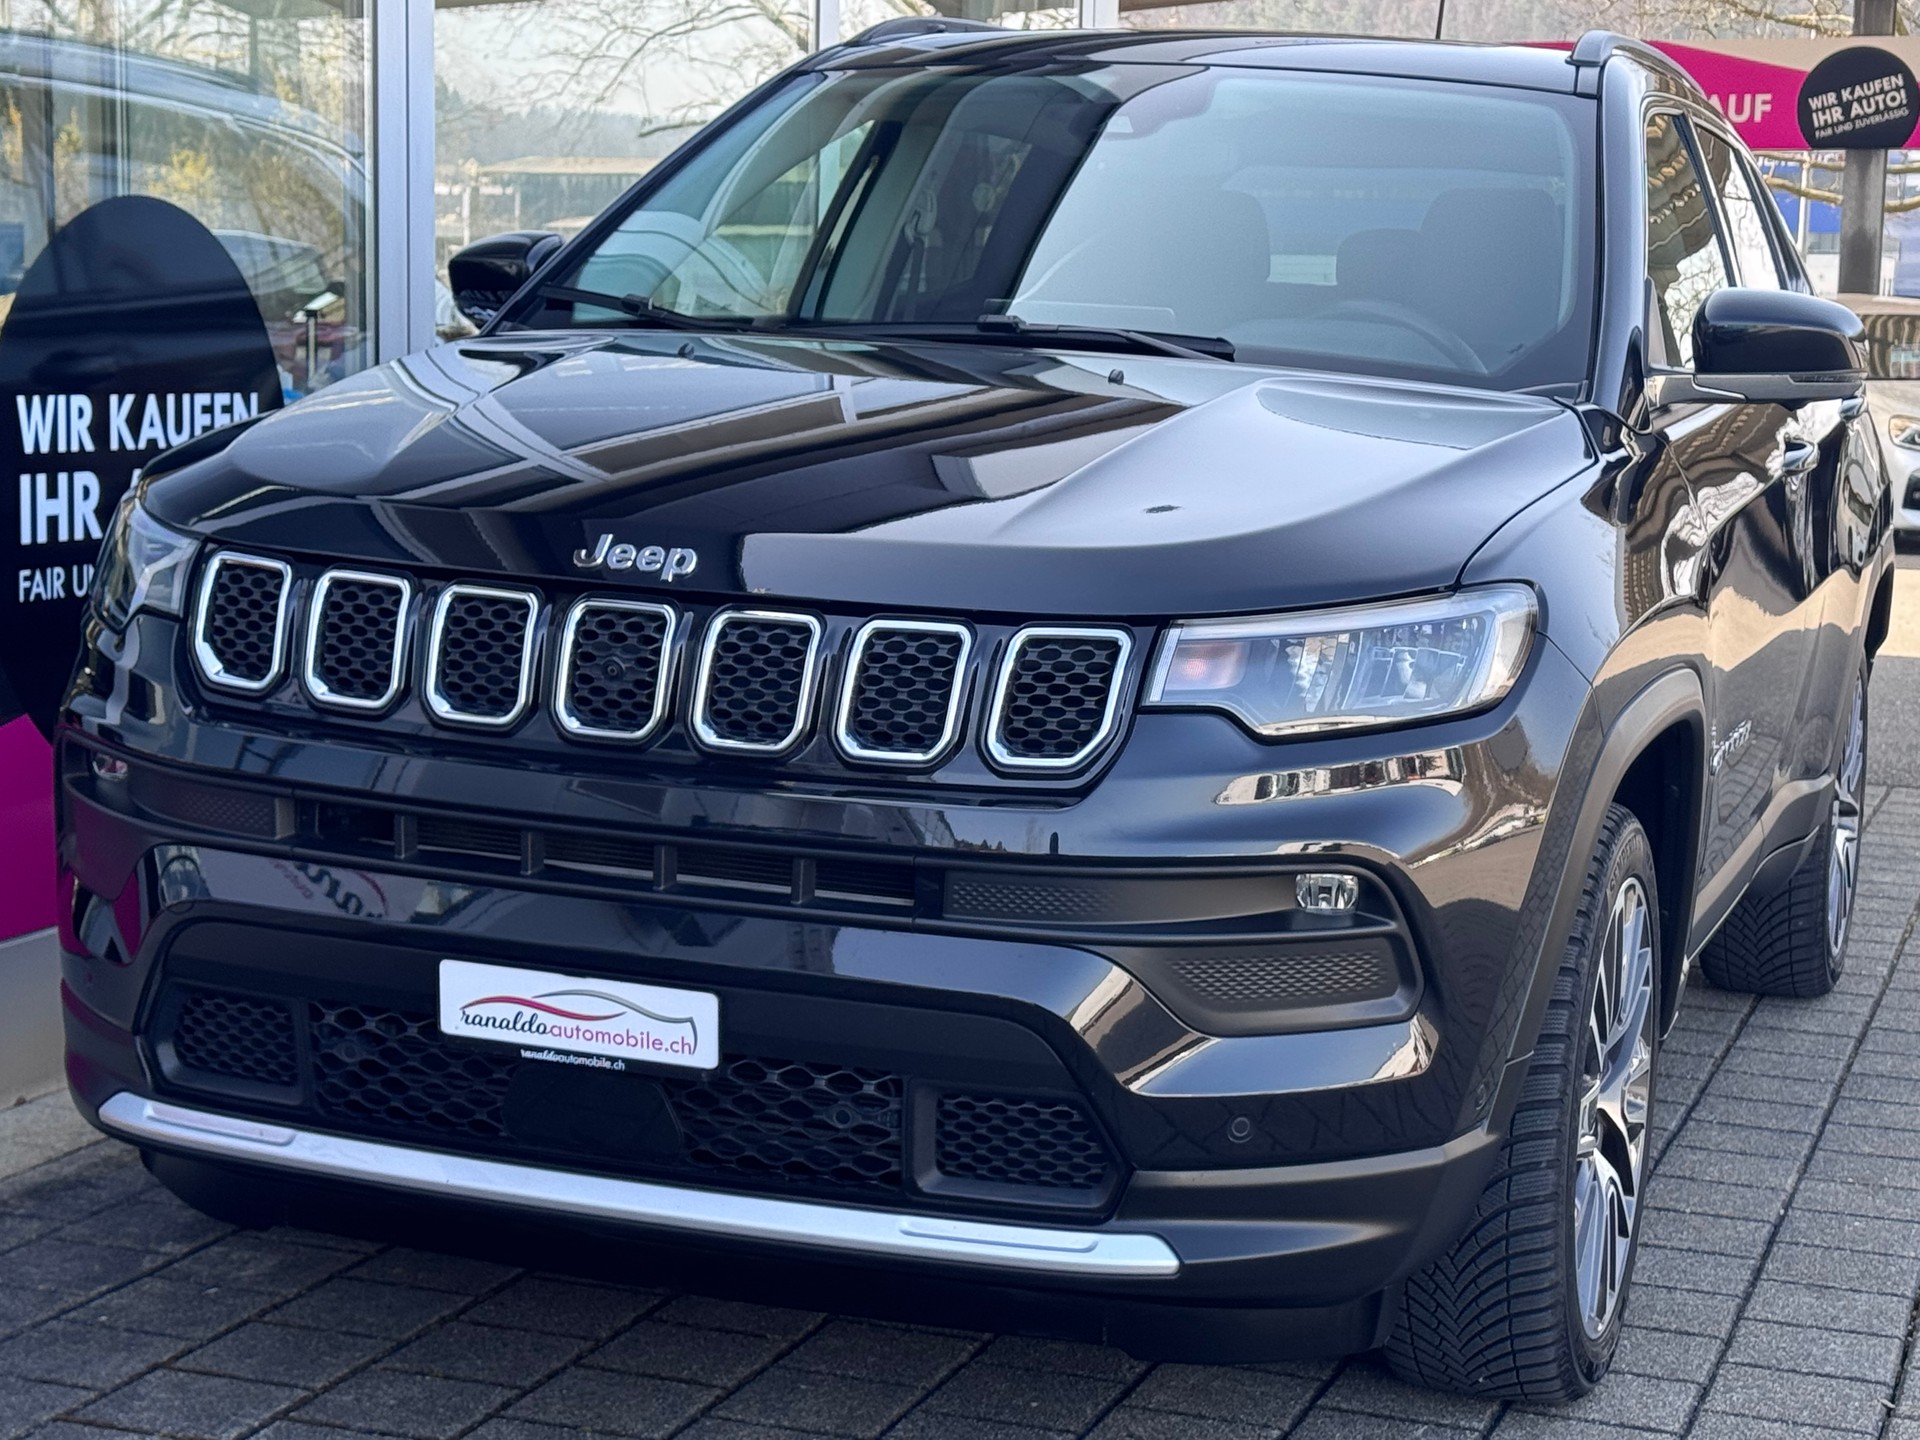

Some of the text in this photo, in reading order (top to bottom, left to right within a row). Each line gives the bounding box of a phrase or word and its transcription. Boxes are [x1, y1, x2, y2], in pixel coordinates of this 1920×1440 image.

[1808, 73, 1904, 111] WIR KAUFEN
[1812, 88, 1907, 129] IHR AUTO!
[1815, 127, 1833, 139] FAIR
[1834, 121, 1854, 134] UND
[16, 394, 95, 454] WIR
[20, 471, 103, 545] IHR
[573, 533, 698, 582] Jeep
[19, 566, 65, 602] FAIR
